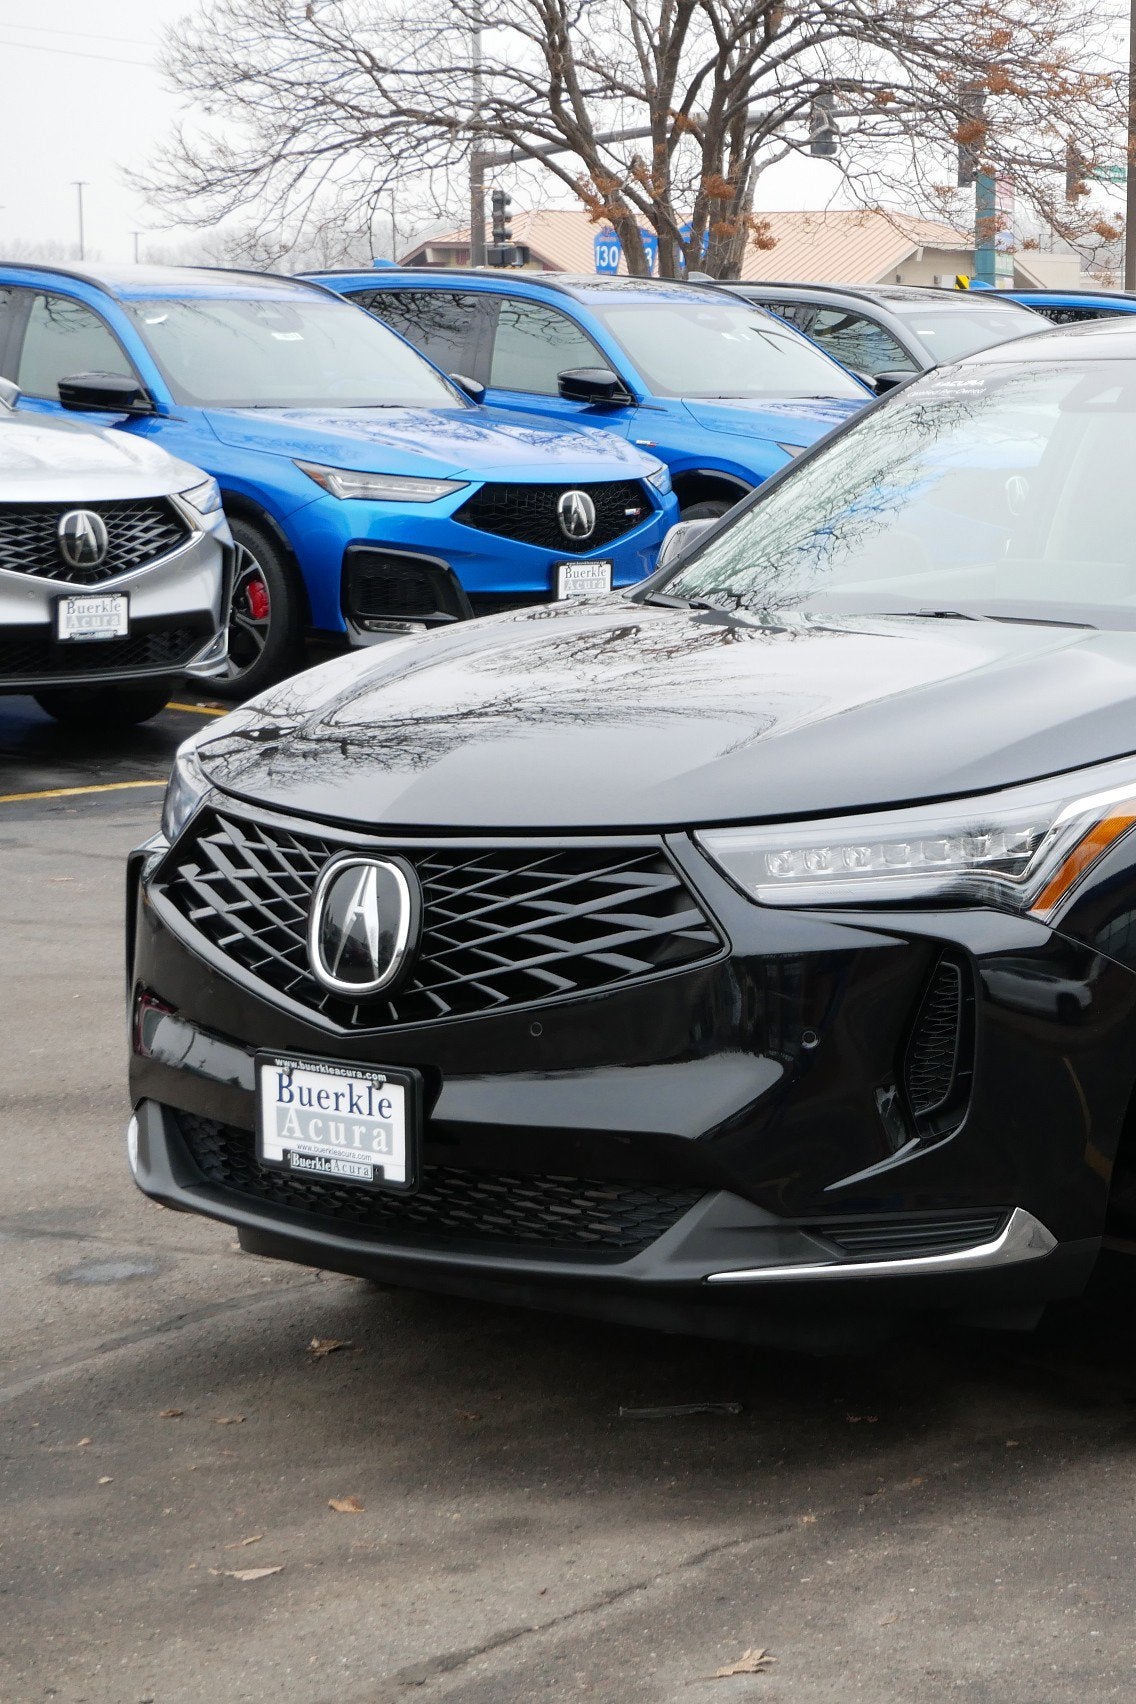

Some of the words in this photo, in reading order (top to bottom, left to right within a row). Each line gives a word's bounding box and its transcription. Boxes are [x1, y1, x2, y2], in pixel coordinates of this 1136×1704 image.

[596, 245, 619, 267] 130
[565, 565, 607, 579] Buerkle
[566, 579, 606, 590] Acura
[66, 600, 121, 615] Buerkle
[68, 614, 120, 628] Acura
[275, 1058, 387, 1082] www.buerkleacura.com
[276, 1072, 393, 1119] Buerkle
[281, 1106, 389, 1152] Acura
[297, 1142, 373, 1162] www.buerkleacura.com
